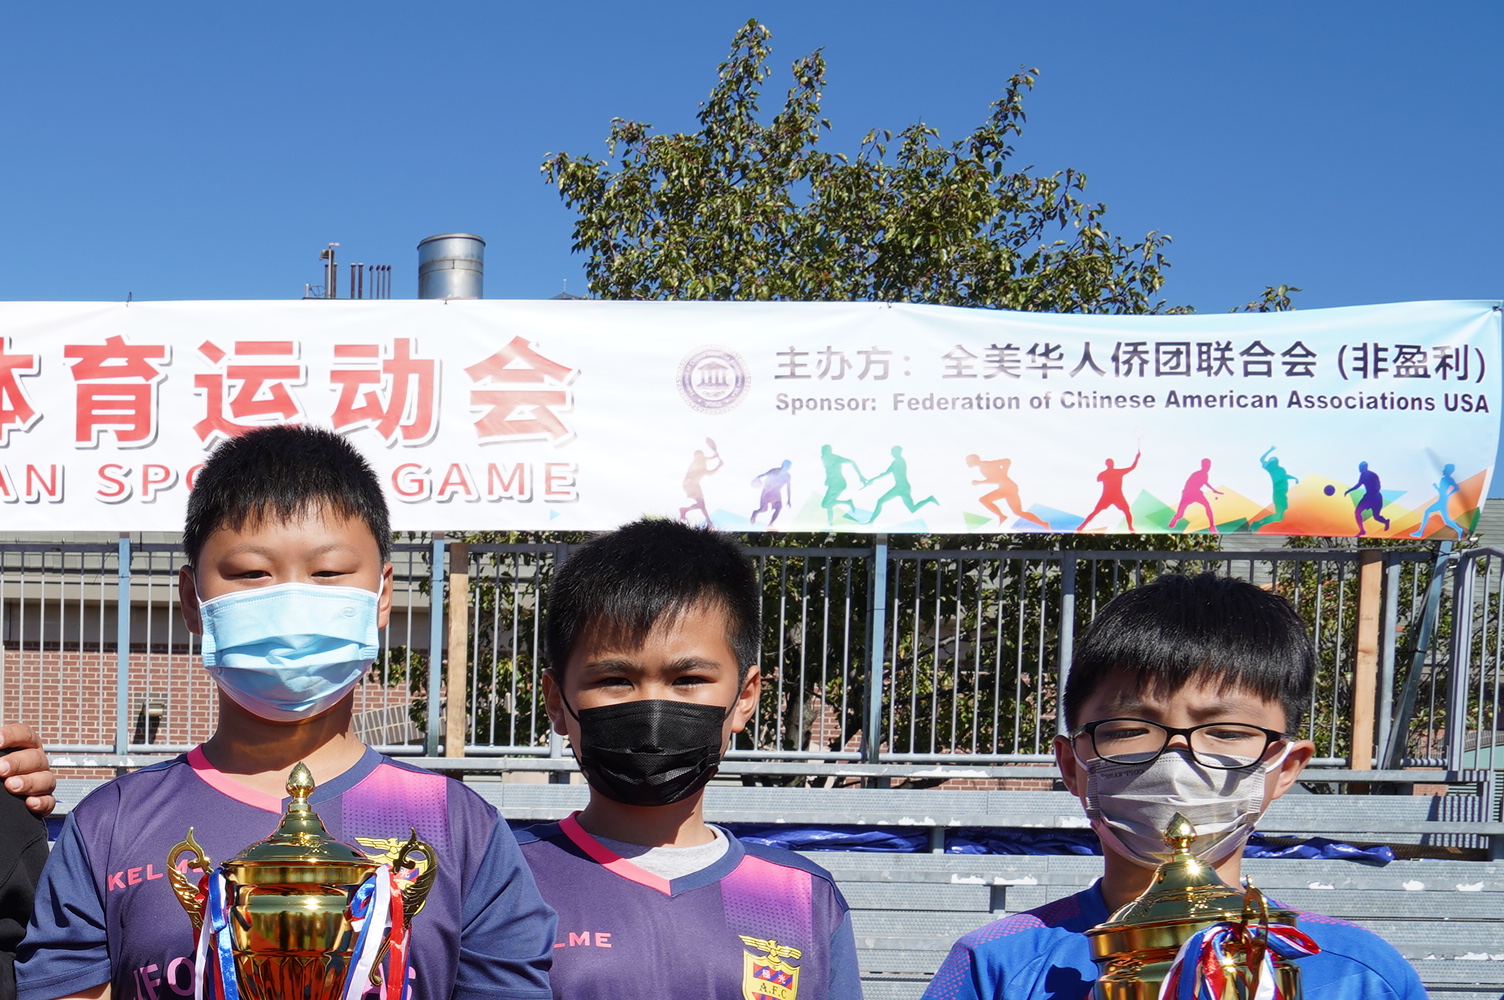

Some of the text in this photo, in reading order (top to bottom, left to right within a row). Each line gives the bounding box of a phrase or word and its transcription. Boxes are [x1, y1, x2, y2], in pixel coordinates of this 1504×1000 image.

[775, 388, 1491, 415] Sponsor: Federation of Chinese American Associations USA
[391, 462, 577, 501] GAME
